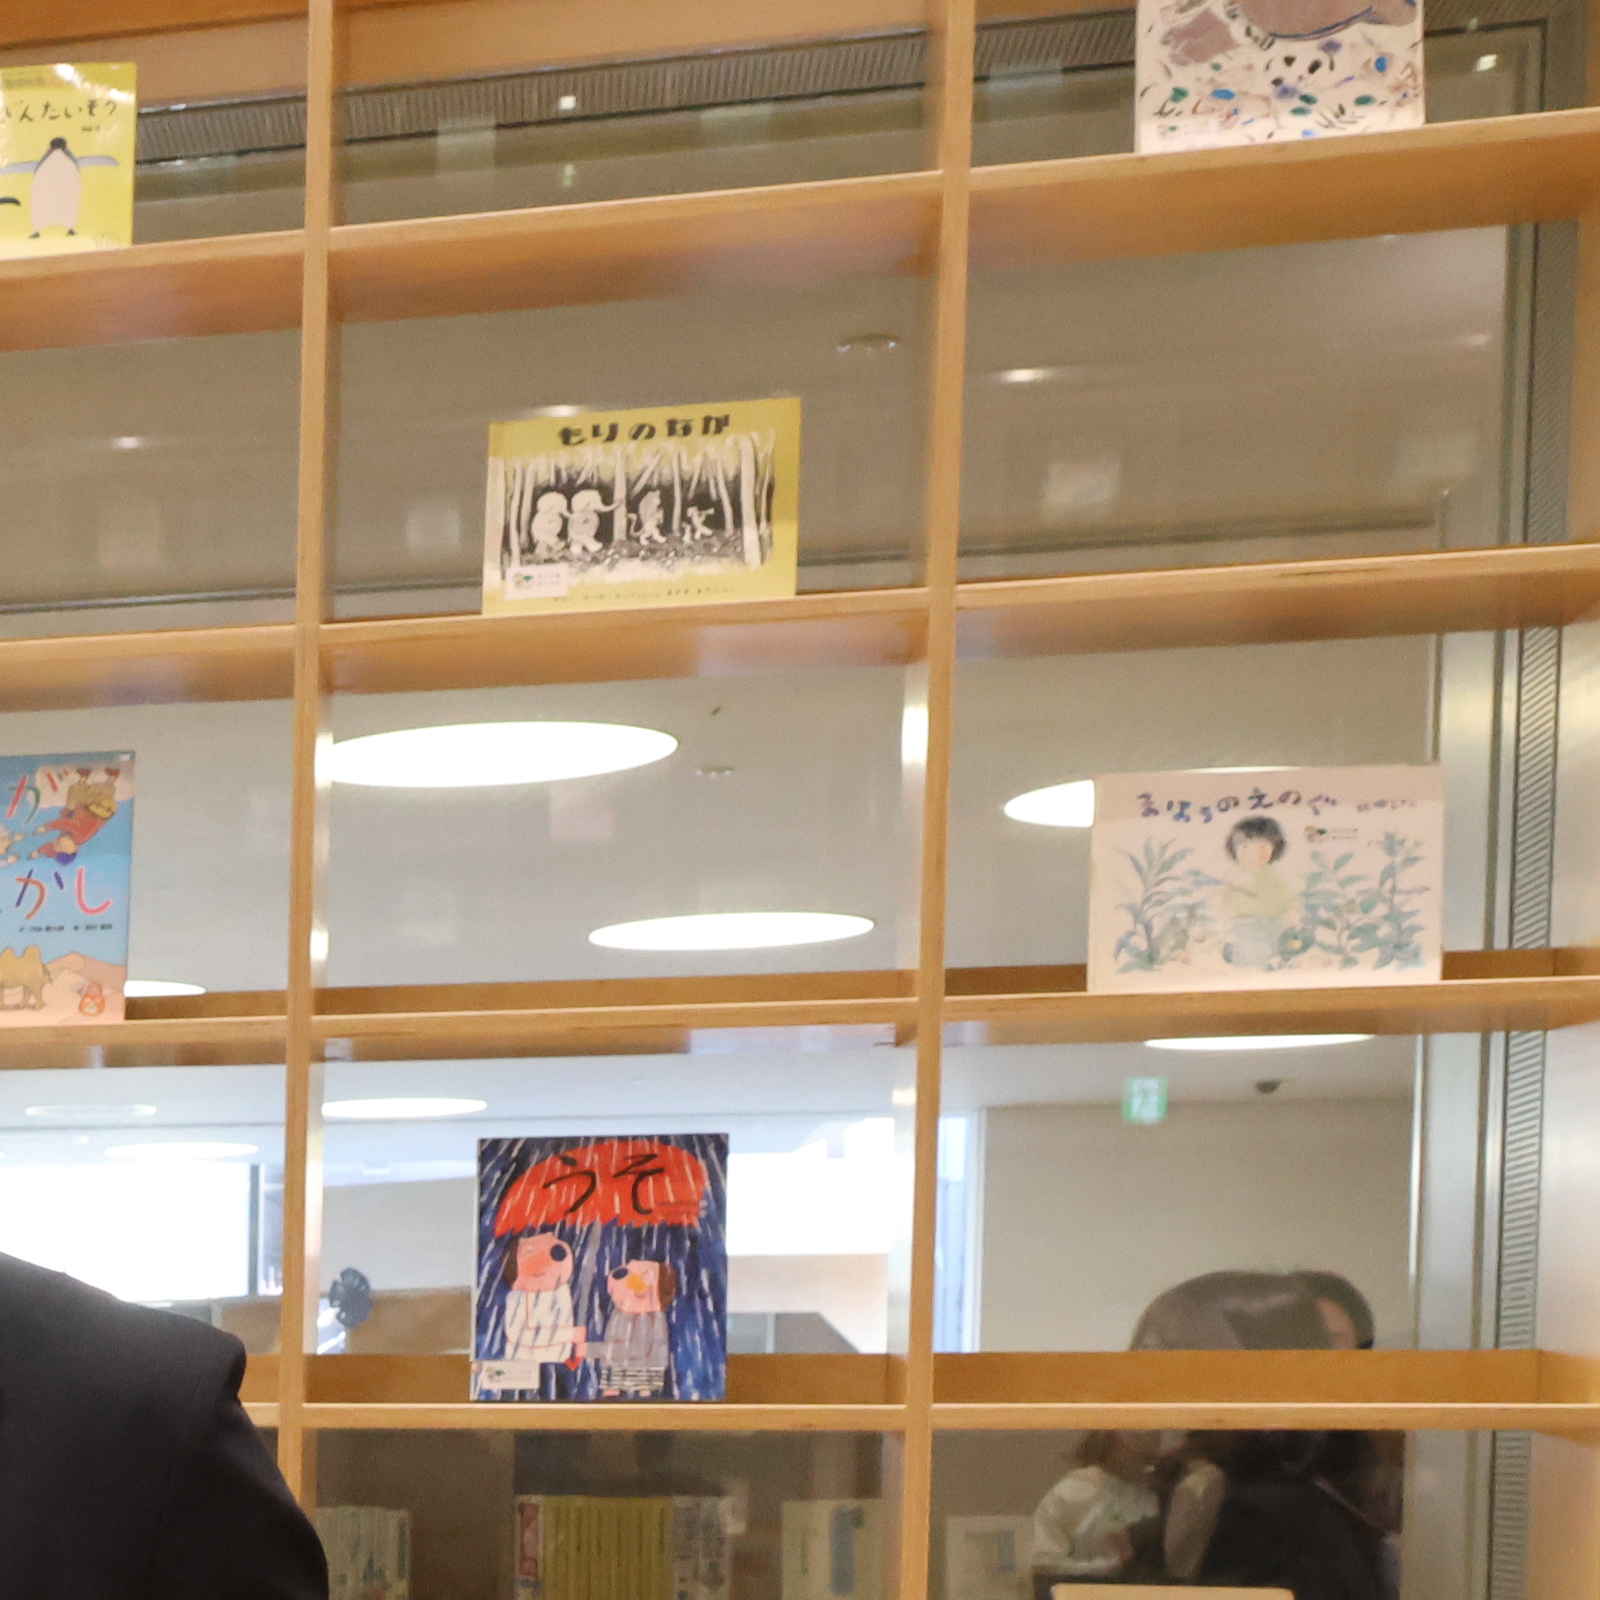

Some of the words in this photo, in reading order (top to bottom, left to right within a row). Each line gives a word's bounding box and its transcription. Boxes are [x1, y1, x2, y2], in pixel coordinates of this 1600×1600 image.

[558, 413, 731, 447] もりのなか
[541, 1154, 666, 1217] うそ
